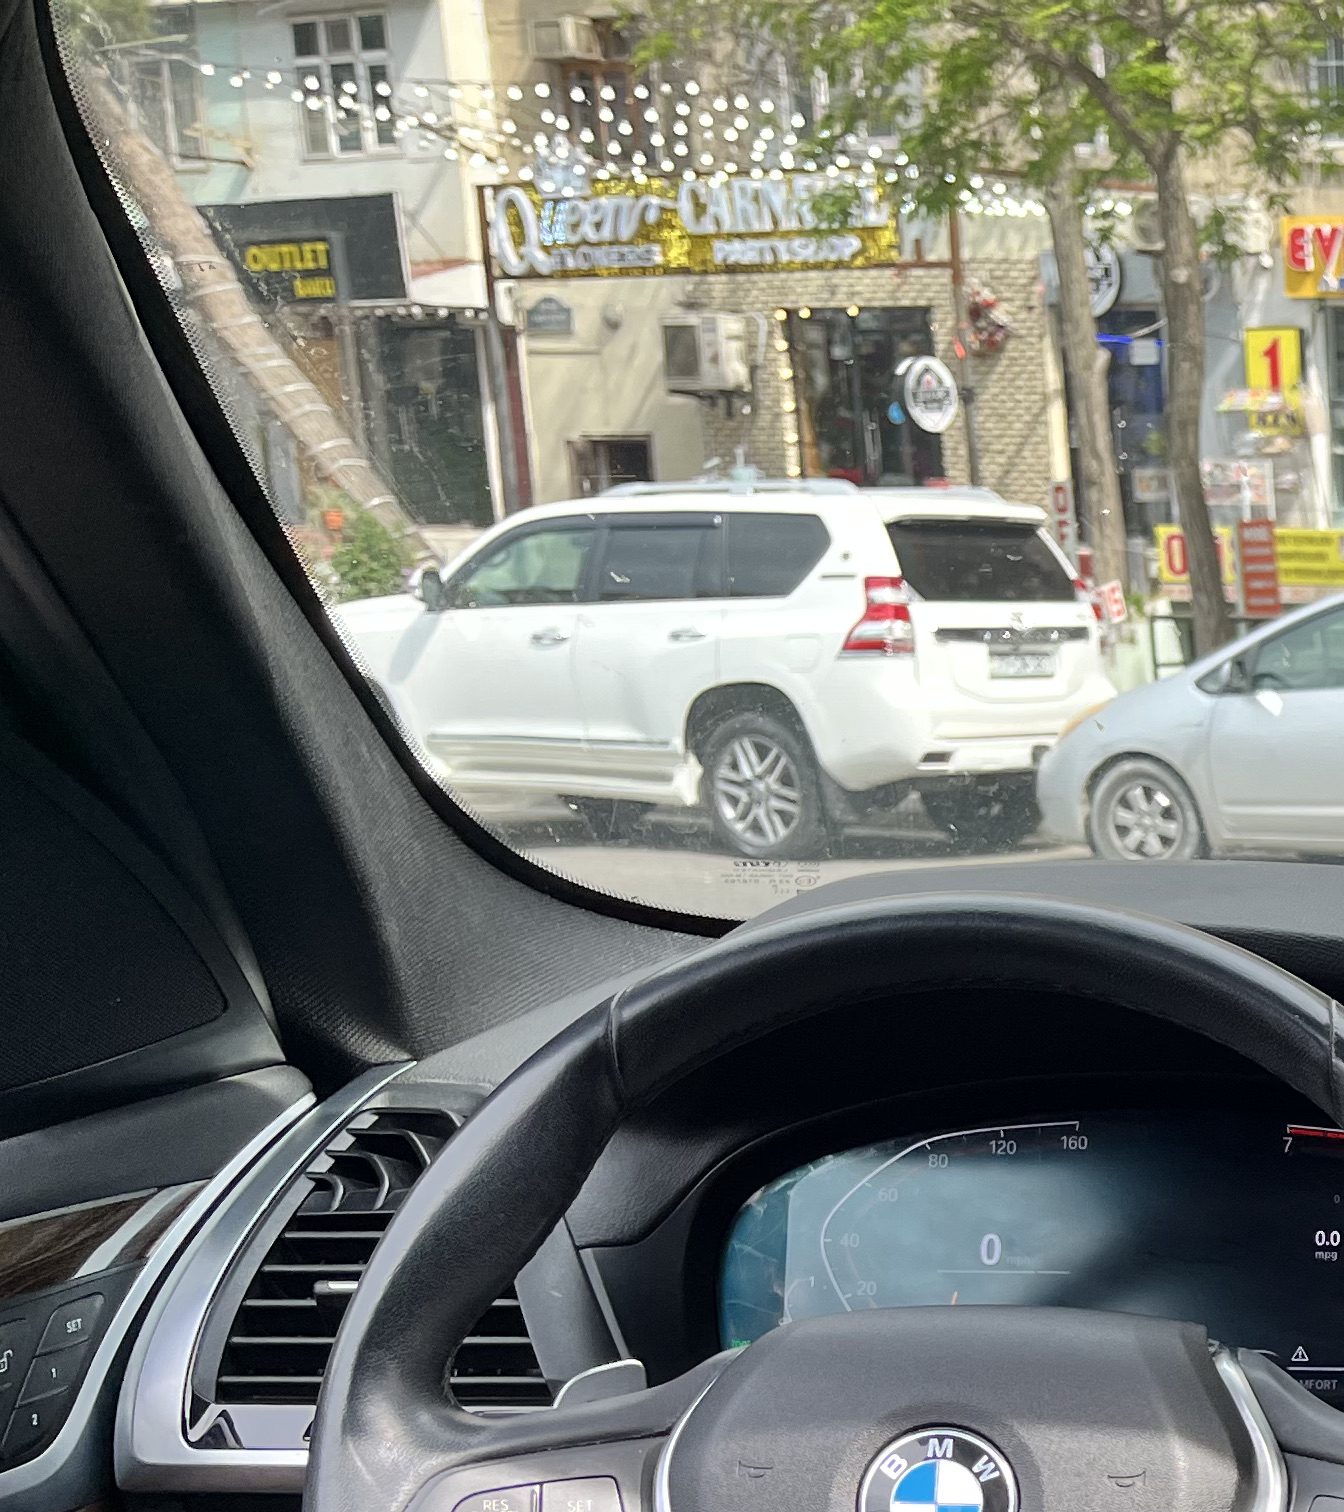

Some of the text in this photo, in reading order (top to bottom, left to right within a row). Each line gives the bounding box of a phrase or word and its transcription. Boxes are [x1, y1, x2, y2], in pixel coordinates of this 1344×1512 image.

[245, 240, 329, 271] OUTLET
[989, 1140, 1017, 1155] 120
[1060, 1135, 1088, 1151] 160
[1283, 1137, 1293, 1153] 7
[928, 1153, 949, 1169] 80
[878, 1187, 898, 1202] 60
[840, 1233, 860, 1248] 40
[1314, 1230, 1341, 1247] 0.0
[980, 1233, 1002, 1266] 0
[1314, 1251, 1338, 1262] mpg
[856, 1281, 877, 1296] 20
[482, 1500, 509, 1511] RES
[567, 1500, 593, 1512] SET
